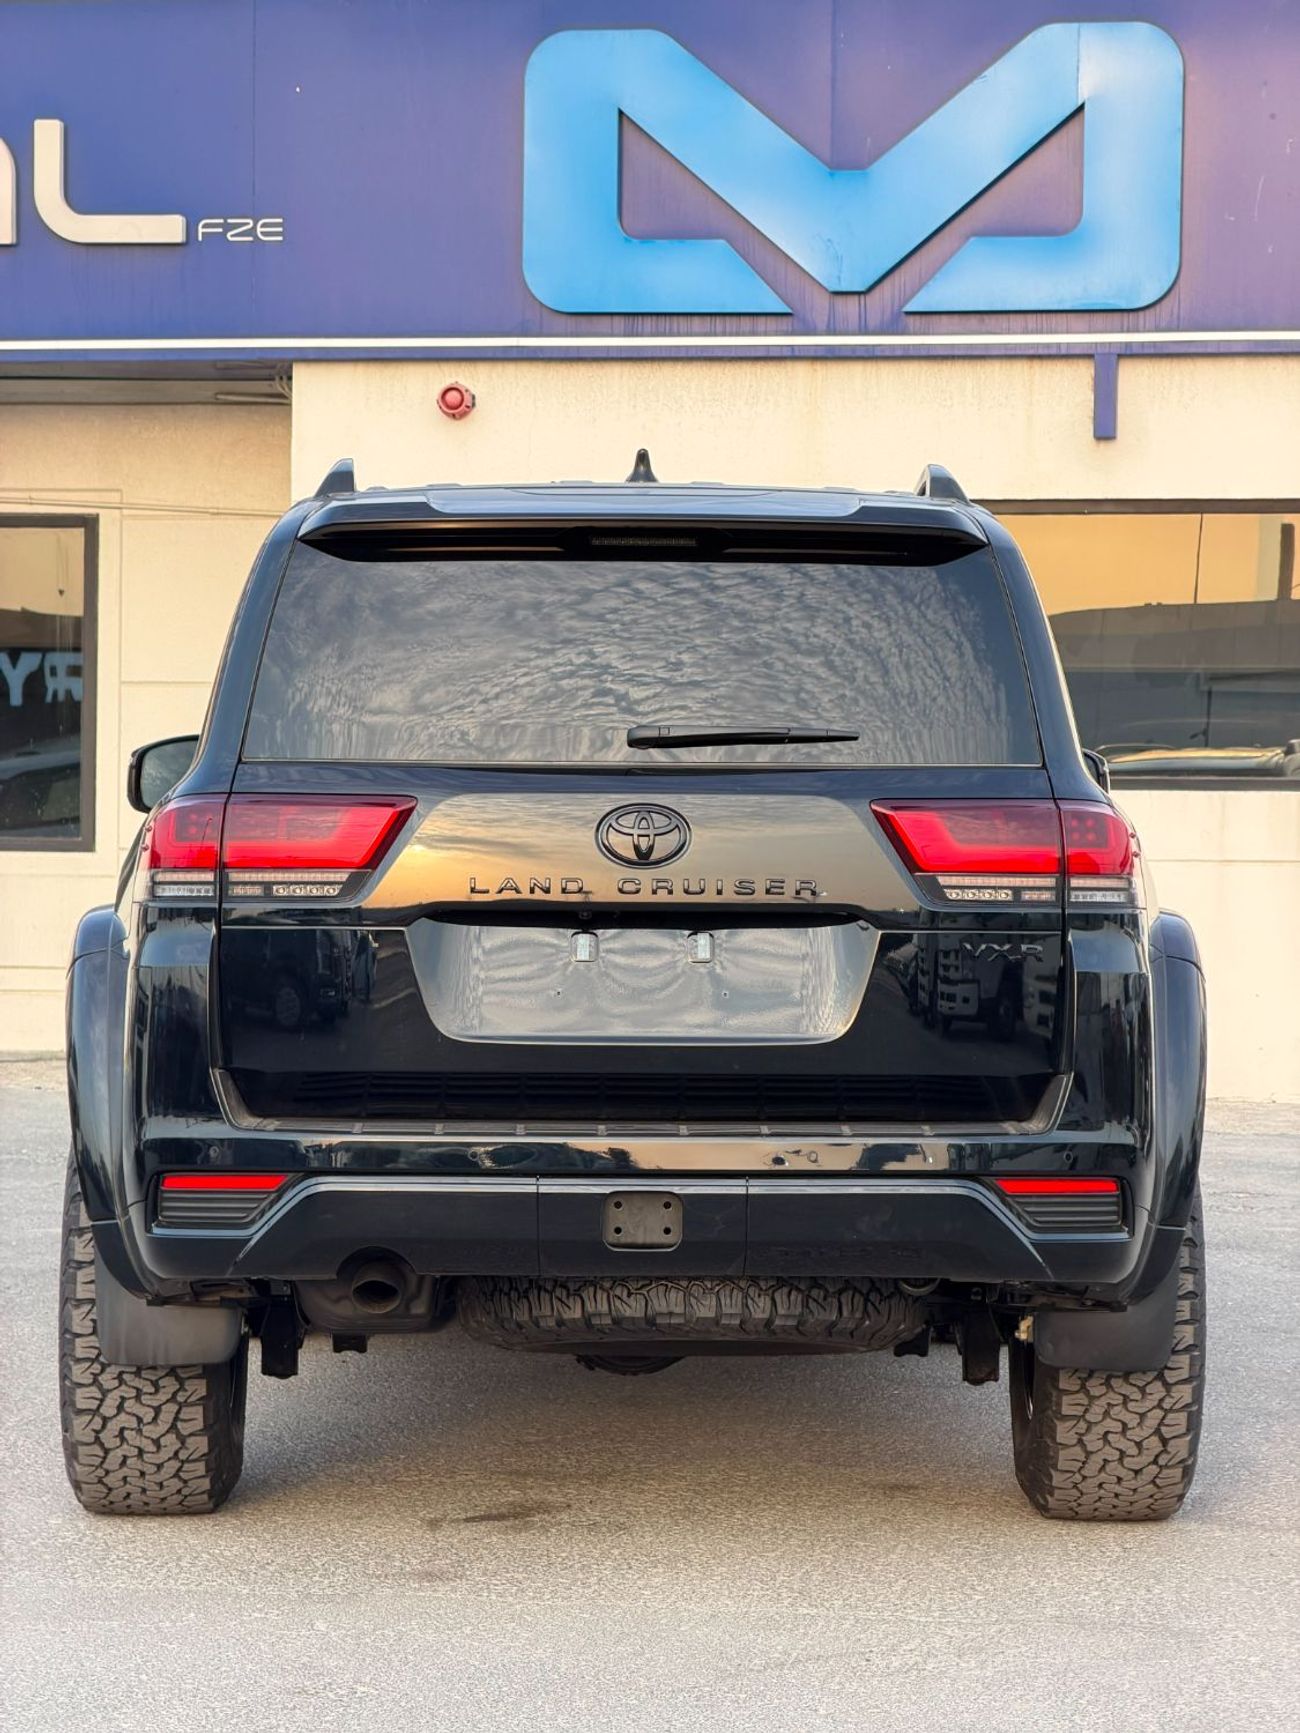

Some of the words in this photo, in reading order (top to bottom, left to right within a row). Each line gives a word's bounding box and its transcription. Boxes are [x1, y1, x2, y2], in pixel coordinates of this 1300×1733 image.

[198, 219, 284, 242] FZE
[469, 877, 584, 895] LAND
[617, 879, 819, 897] CRUISER
[962, 942, 1044, 963] VXR
